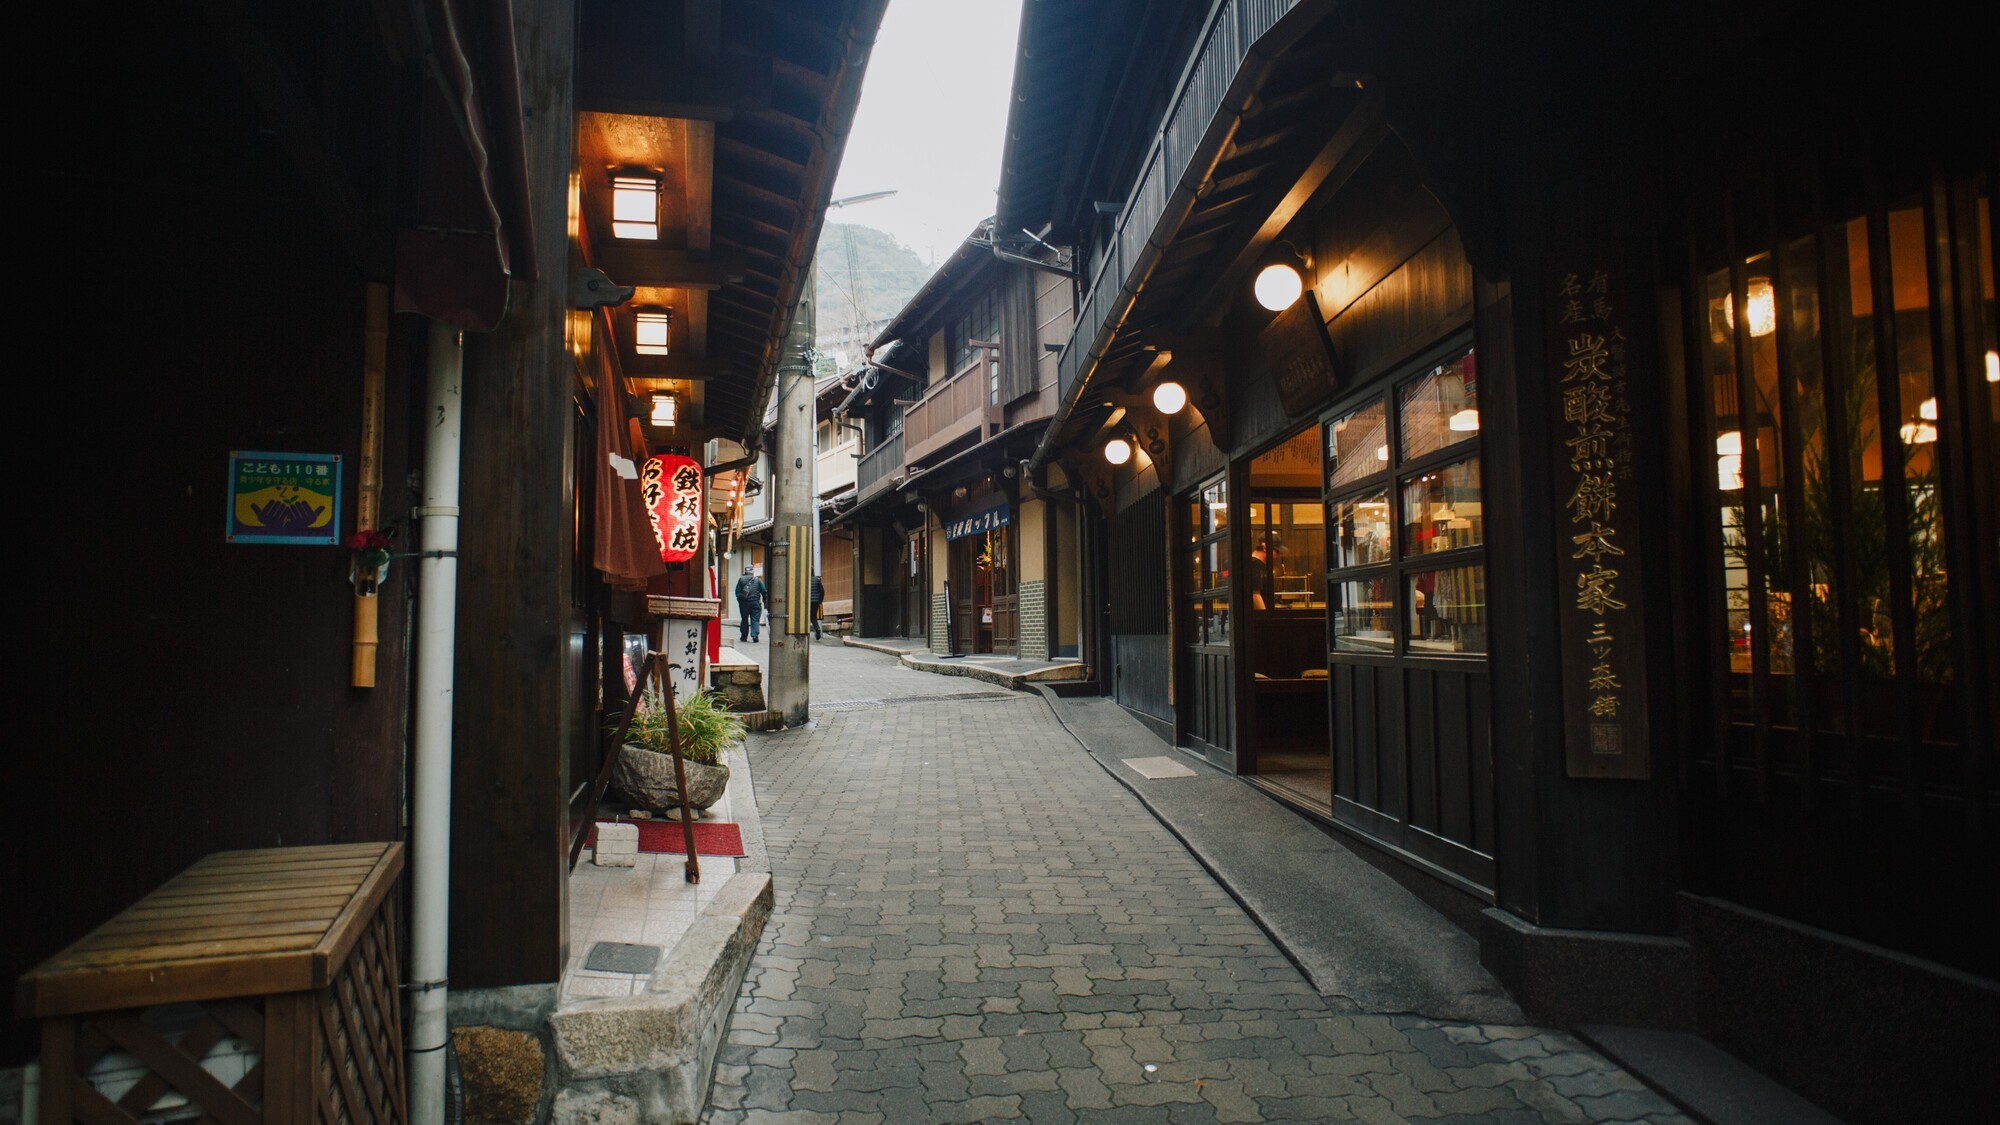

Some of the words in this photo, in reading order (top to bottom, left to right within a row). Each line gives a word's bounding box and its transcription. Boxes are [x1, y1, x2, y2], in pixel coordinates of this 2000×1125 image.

[242, 462, 329, 476] こども110番
[672, 467, 700, 549] 鉄板焼
